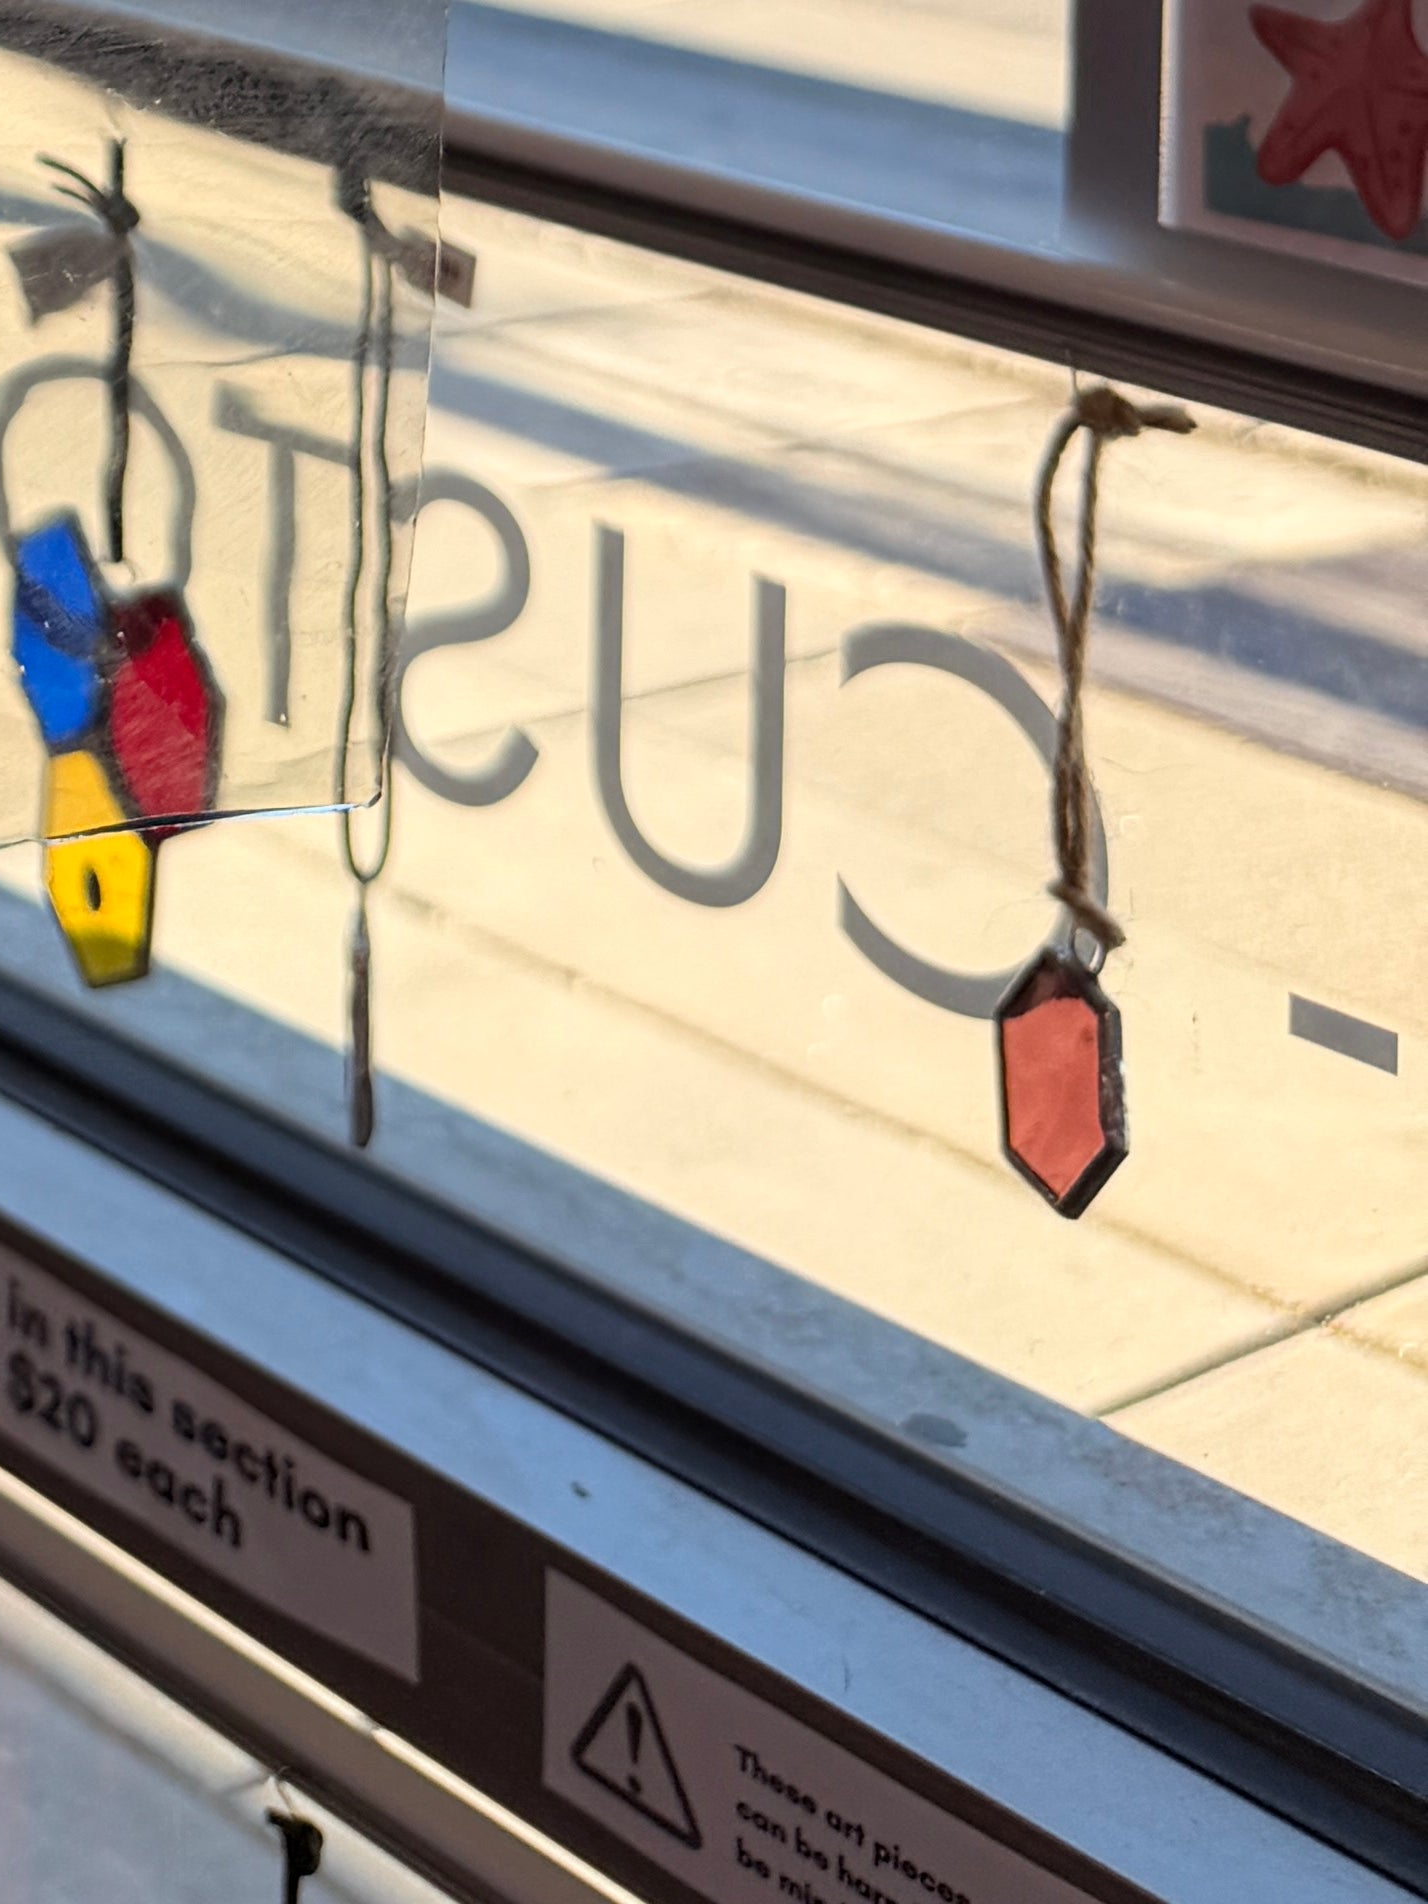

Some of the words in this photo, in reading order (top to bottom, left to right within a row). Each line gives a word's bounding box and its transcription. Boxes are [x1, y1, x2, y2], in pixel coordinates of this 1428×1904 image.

[5, 1348, 99, 1451] $20
[114, 1435, 244, 1550] each
[7, 1274, 49, 1348] in
[63, 1314, 156, 1415] this
[170, 1397, 372, 1554] section
[734, 1742, 818, 1815] These
[825, 1809, 866, 1847] art
[736, 1800, 788, 1844] can
[795, 1826, 829, 1871] be
[736, 1836, 770, 1879] be
